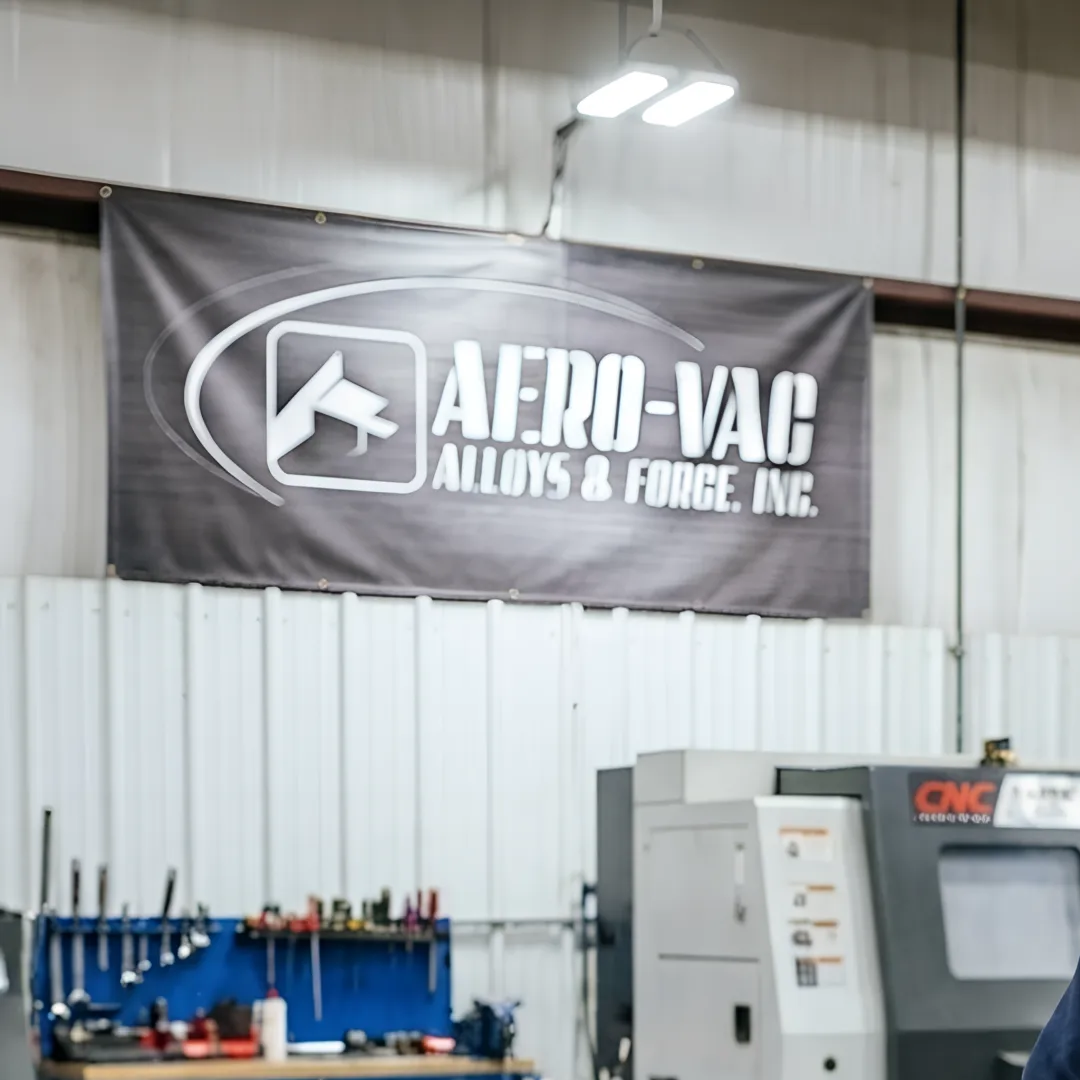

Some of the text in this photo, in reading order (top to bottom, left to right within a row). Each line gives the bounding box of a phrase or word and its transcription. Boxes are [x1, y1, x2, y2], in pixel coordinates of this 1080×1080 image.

[431, 339, 818, 467] AERO-VAC
[431, 442, 572, 500] ALLOYS
[580, 454, 613, 502] &
[751, 467, 819, 518] INC.
[914, 779, 997, 814] CNC
